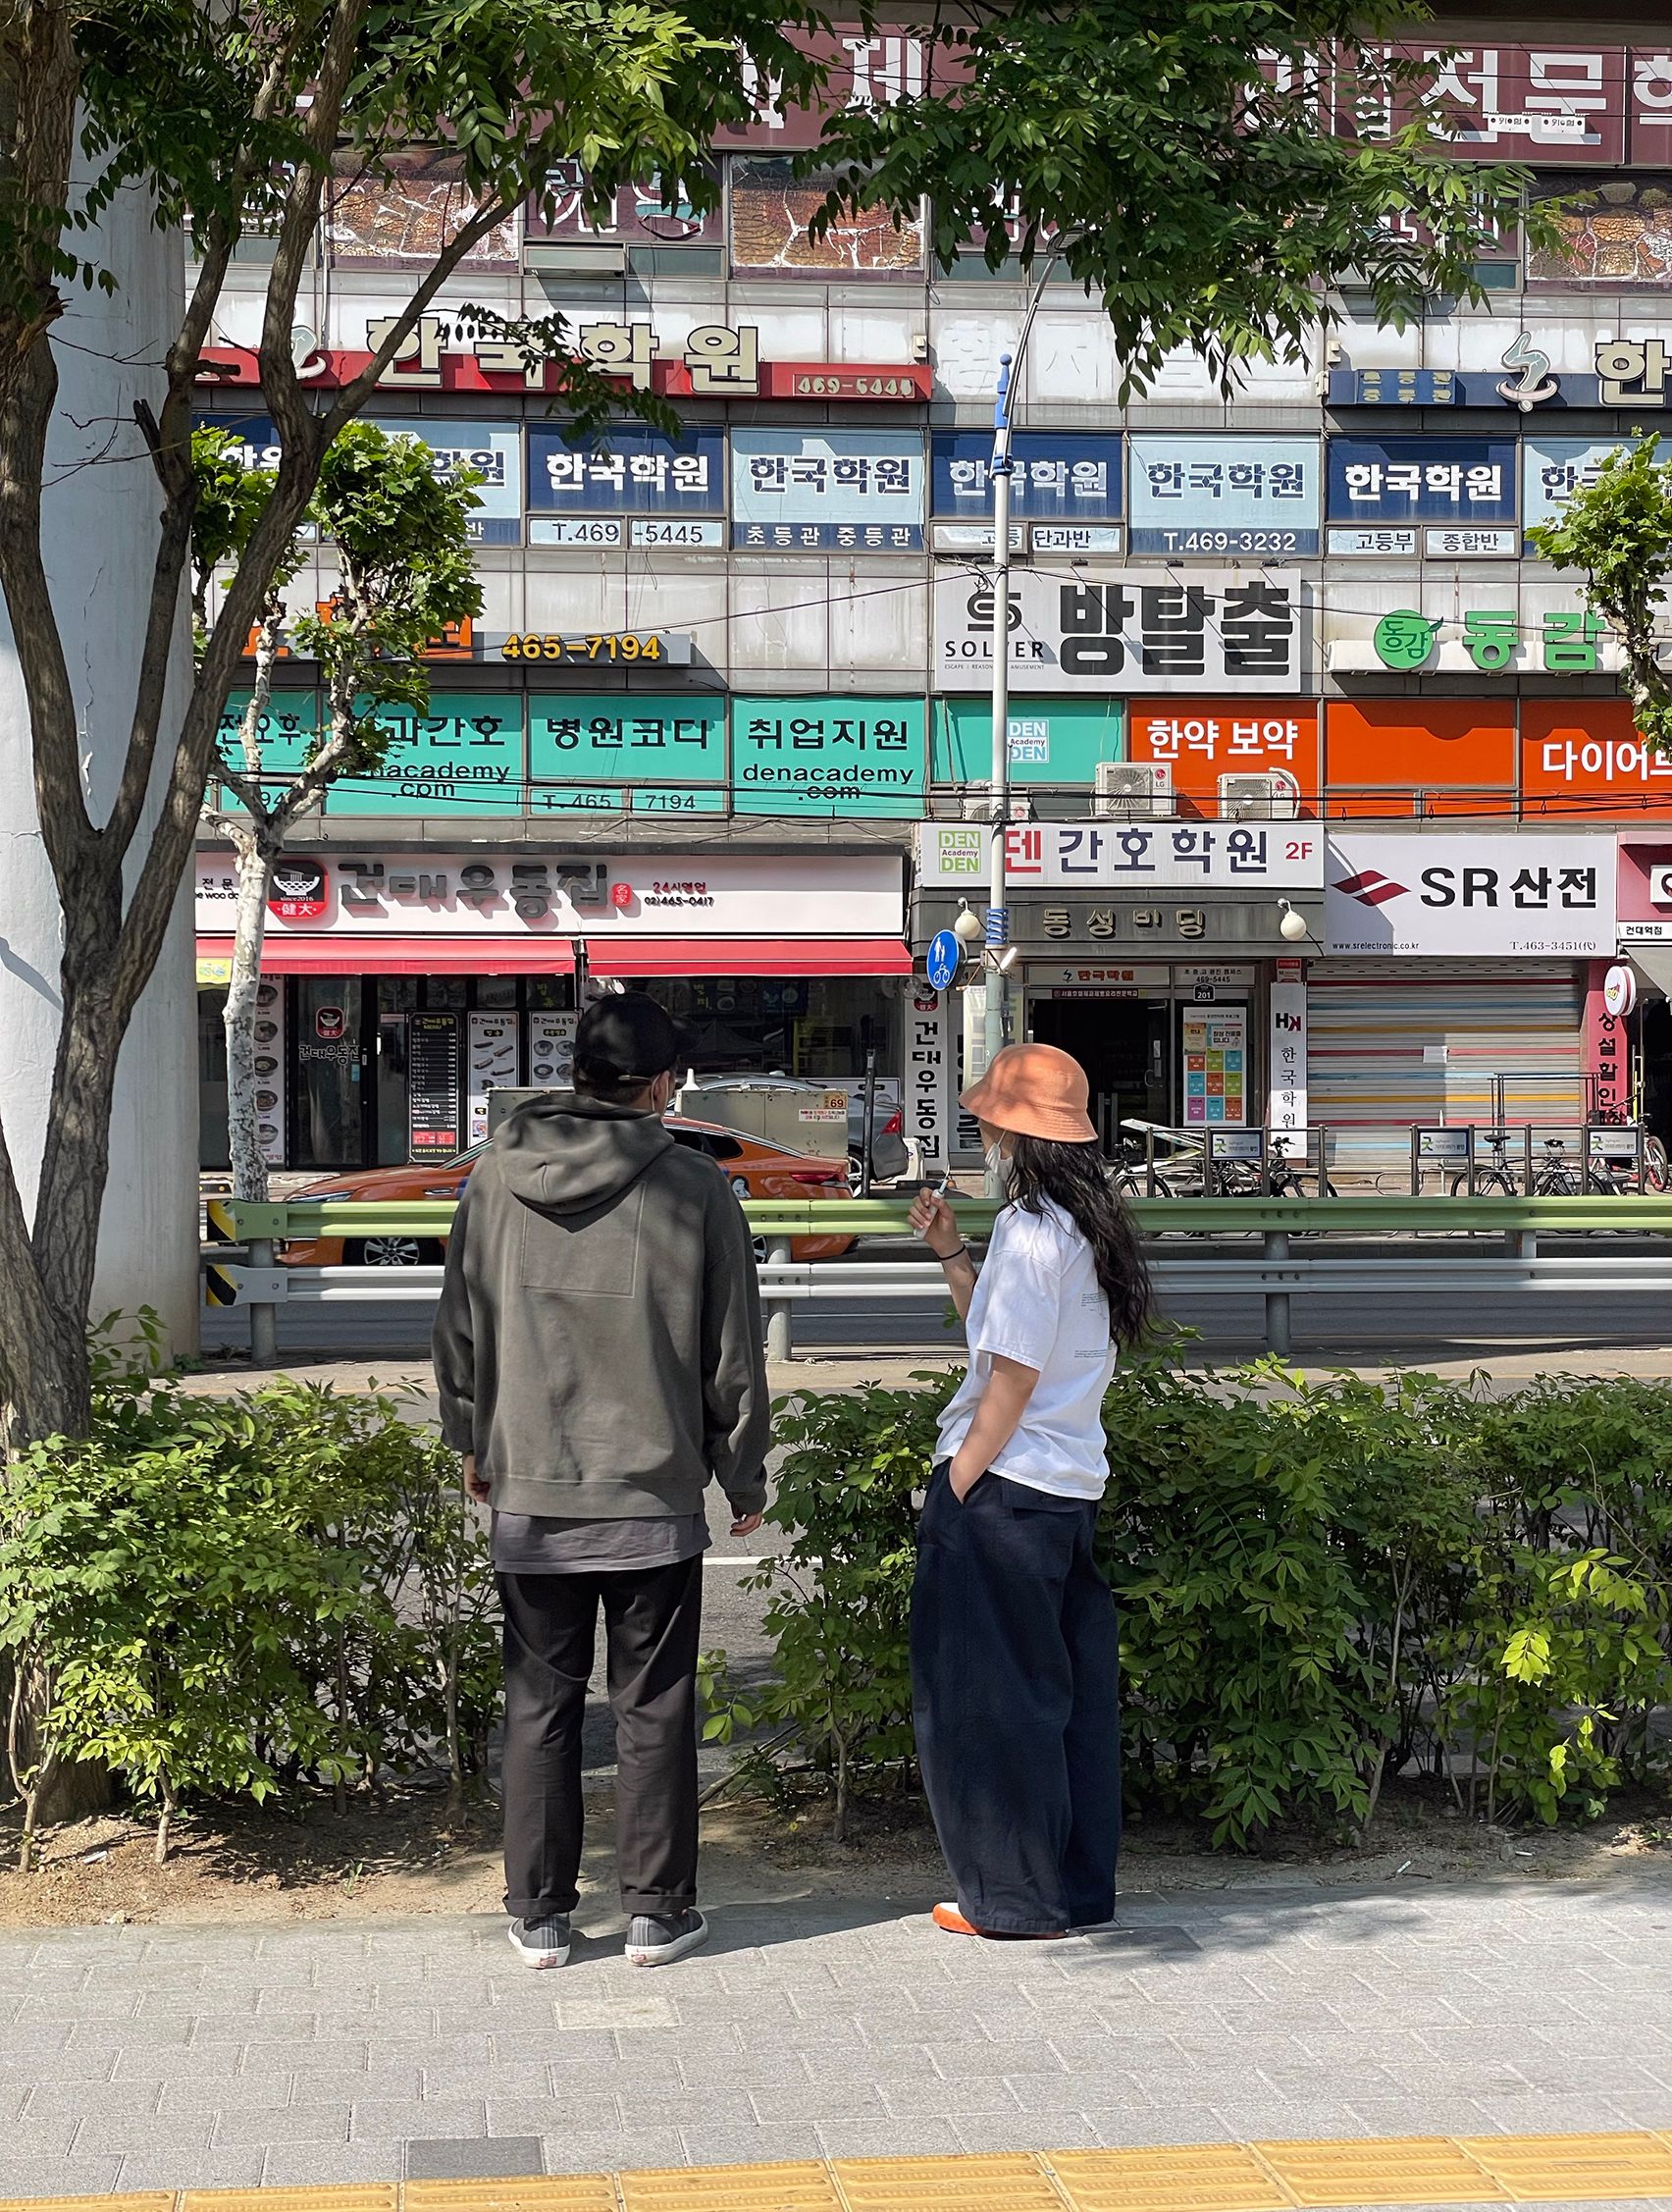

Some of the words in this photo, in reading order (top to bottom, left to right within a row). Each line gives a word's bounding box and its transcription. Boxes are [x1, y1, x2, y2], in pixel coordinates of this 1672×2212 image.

[366, 316, 759, 396] 한국학원
[1594, 340, 1672, 408] 한
[547, 452, 708, 493] 한국학원
[750, 456, 911, 496] 한국학원
[949, 460, 1109, 498] 한국학원
[1146, 461, 1307, 500] 한국학원
[1344, 463, 1502, 502] 한국학원
[552, 522, 619, 543] T.469
[746, 525, 821, 547] 초등관
[837, 526, 912, 548] 중등관
[1033, 529, 1092, 550] 단과반
[1164, 532, 1296, 553] T.469-3232
[1355, 532, 1414, 553] 고등부
[1441, 533, 1499, 553] 종합반
[1059, 580, 1294, 677] 방탈출
[501, 633, 660, 660] 465-7194
[945, 640, 1045, 658] SOLER
[547, 717, 709, 750] 병원코디
[748, 718, 909, 751] 취업지원
[1009, 721, 1047, 737] DEN
[1010, 738, 1046, 747] Academy
[1147, 719, 1220, 761] 한약
[1227, 719, 1299, 761] 보약
[1010, 746, 1047, 761] DEN
[742, 764, 914, 786] denacademy
[644, 794, 697, 811] 7194
[798, 784, 862, 801] .com
[941, 831, 979, 848] DEN
[941, 849, 979, 858] Academy
[1284, 841, 1314, 861] 2F
[941, 857, 979, 871] DEN
[337, 863, 608, 921] 건대우동집
[1420, 867, 1500, 908] SR
[1508, 867, 1598, 909] 산전
[1625, 925, 1663, 936] 건대역점
[1332, 941, 1420, 951] www.srelectronic.co.kr
[298, 1044, 361, 1065] 건대우동집
[912, 1021, 942, 1159] 건대우동집
[1280, 1046, 1297, 1130] 한국학원
[829, 1098, 845, 1108] 69
